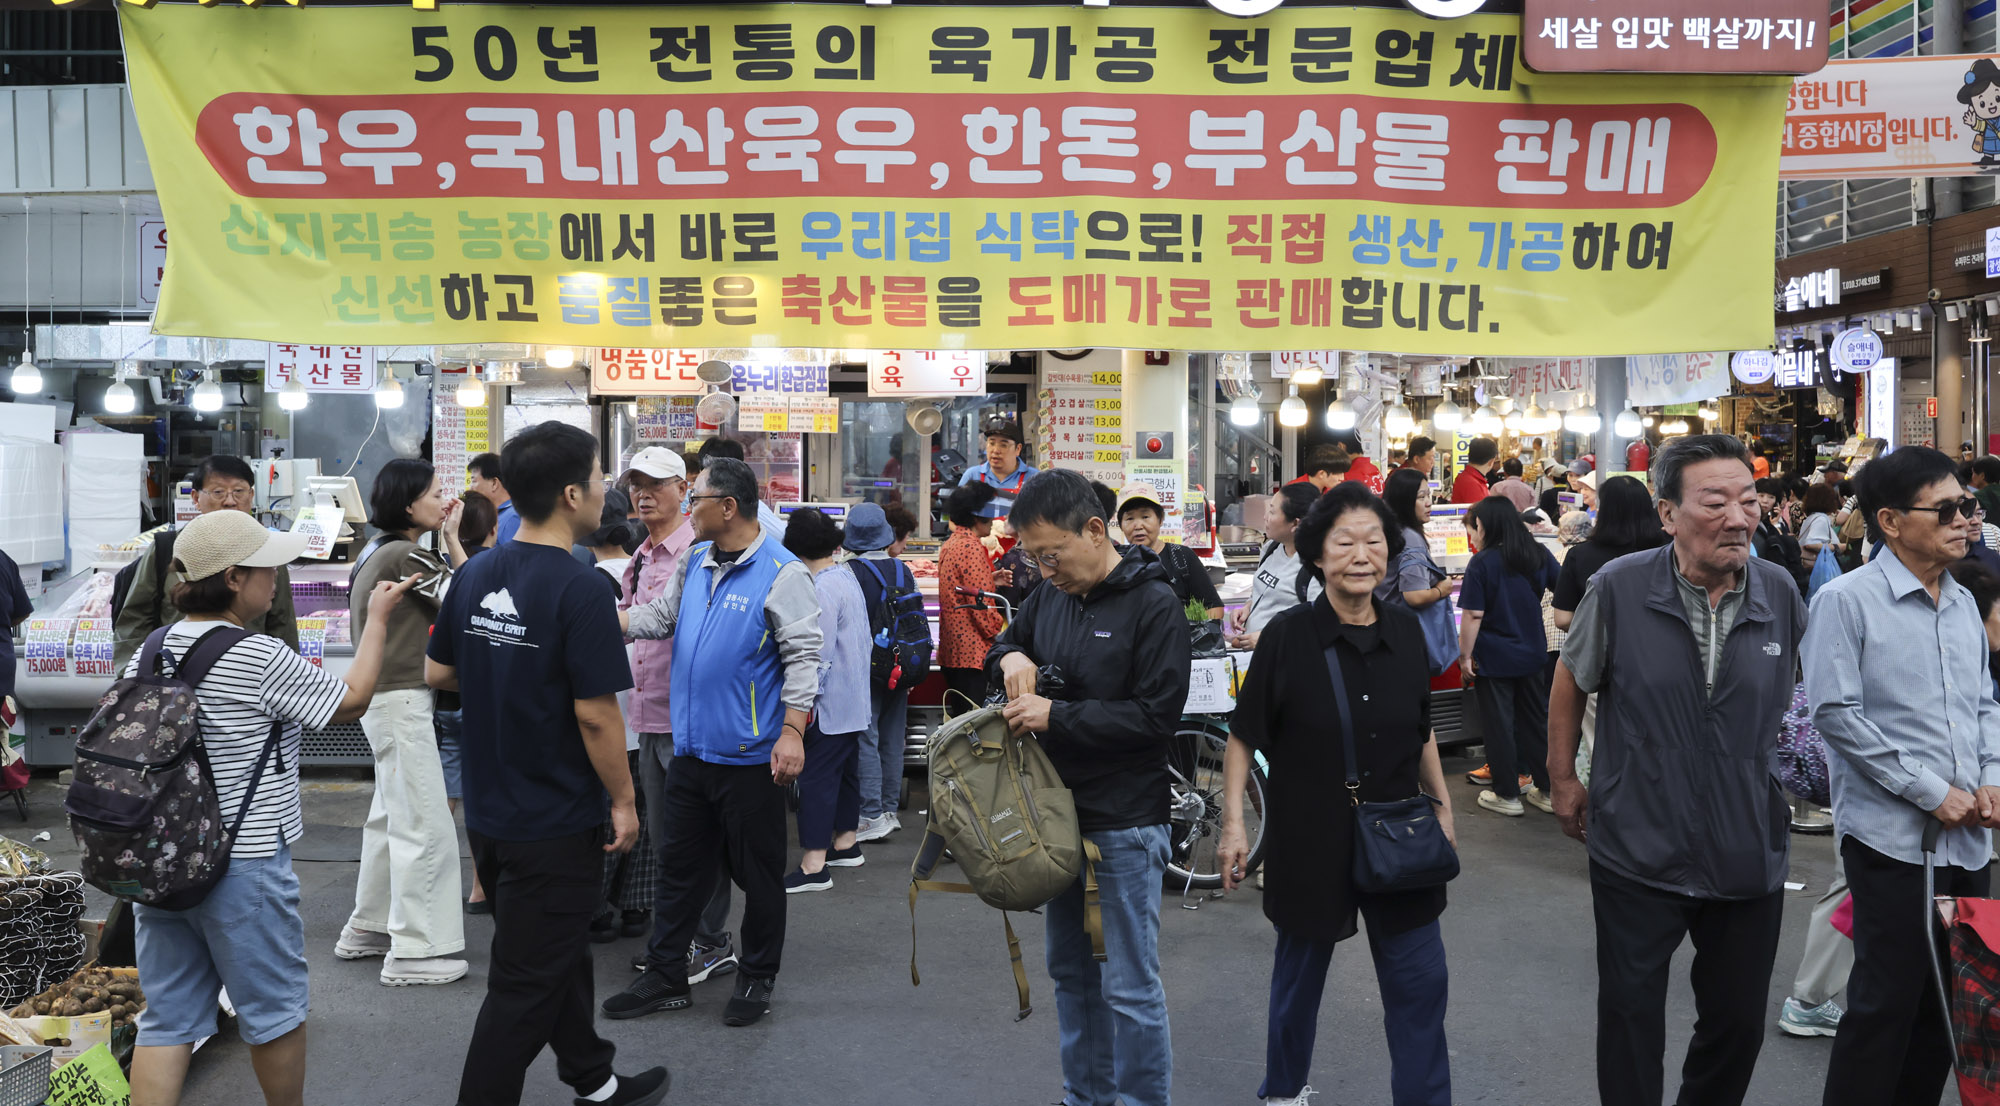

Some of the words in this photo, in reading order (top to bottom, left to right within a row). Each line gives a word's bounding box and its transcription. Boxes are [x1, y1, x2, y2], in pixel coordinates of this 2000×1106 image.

[1539, 17, 1602, 49] 세살
[1611, 17, 1674, 49] 입맛
[1682, 17, 1817, 50] 백살까지!
[412, 25, 600, 82] 50년
[649, 25, 876, 82] 전통의
[929, 26, 1157, 82] 육가공
[1208, 28, 1514, 91] 전문업체
[1495, 117, 1671, 194] 판매
[221, 204, 434, 261] 산지직송
[458, 210, 656, 262] 농장에서
[680, 212, 778, 262] 바로
[801, 211, 951, 263] 우리집
[976, 210, 1202, 263] 식탁으로!
[1227, 213, 1326, 264] 직접
[1348, 213, 1674, 273] 생산,가공하여
[331, 272, 538, 323] 신선하고
[558, 275, 758, 327] 품질좋은
[781, 273, 983, 327] 축산물을
[1008, 273, 1212, 327] 도매가로
[1236, 277, 1500, 333] 판매합니다.
[1785, 268, 1840, 312] 슬애네
[732, 364, 778, 393] 온누리
[781, 365, 828, 392] 환급점포
[466, 432, 488, 440] 12,000
[1049, 451, 1085, 460] 생앞다리살
[504, 623, 527, 636] ESPRIT
[26, 658, 66, 674] 75,000원
[76, 660, 115, 675] 최저가!!
